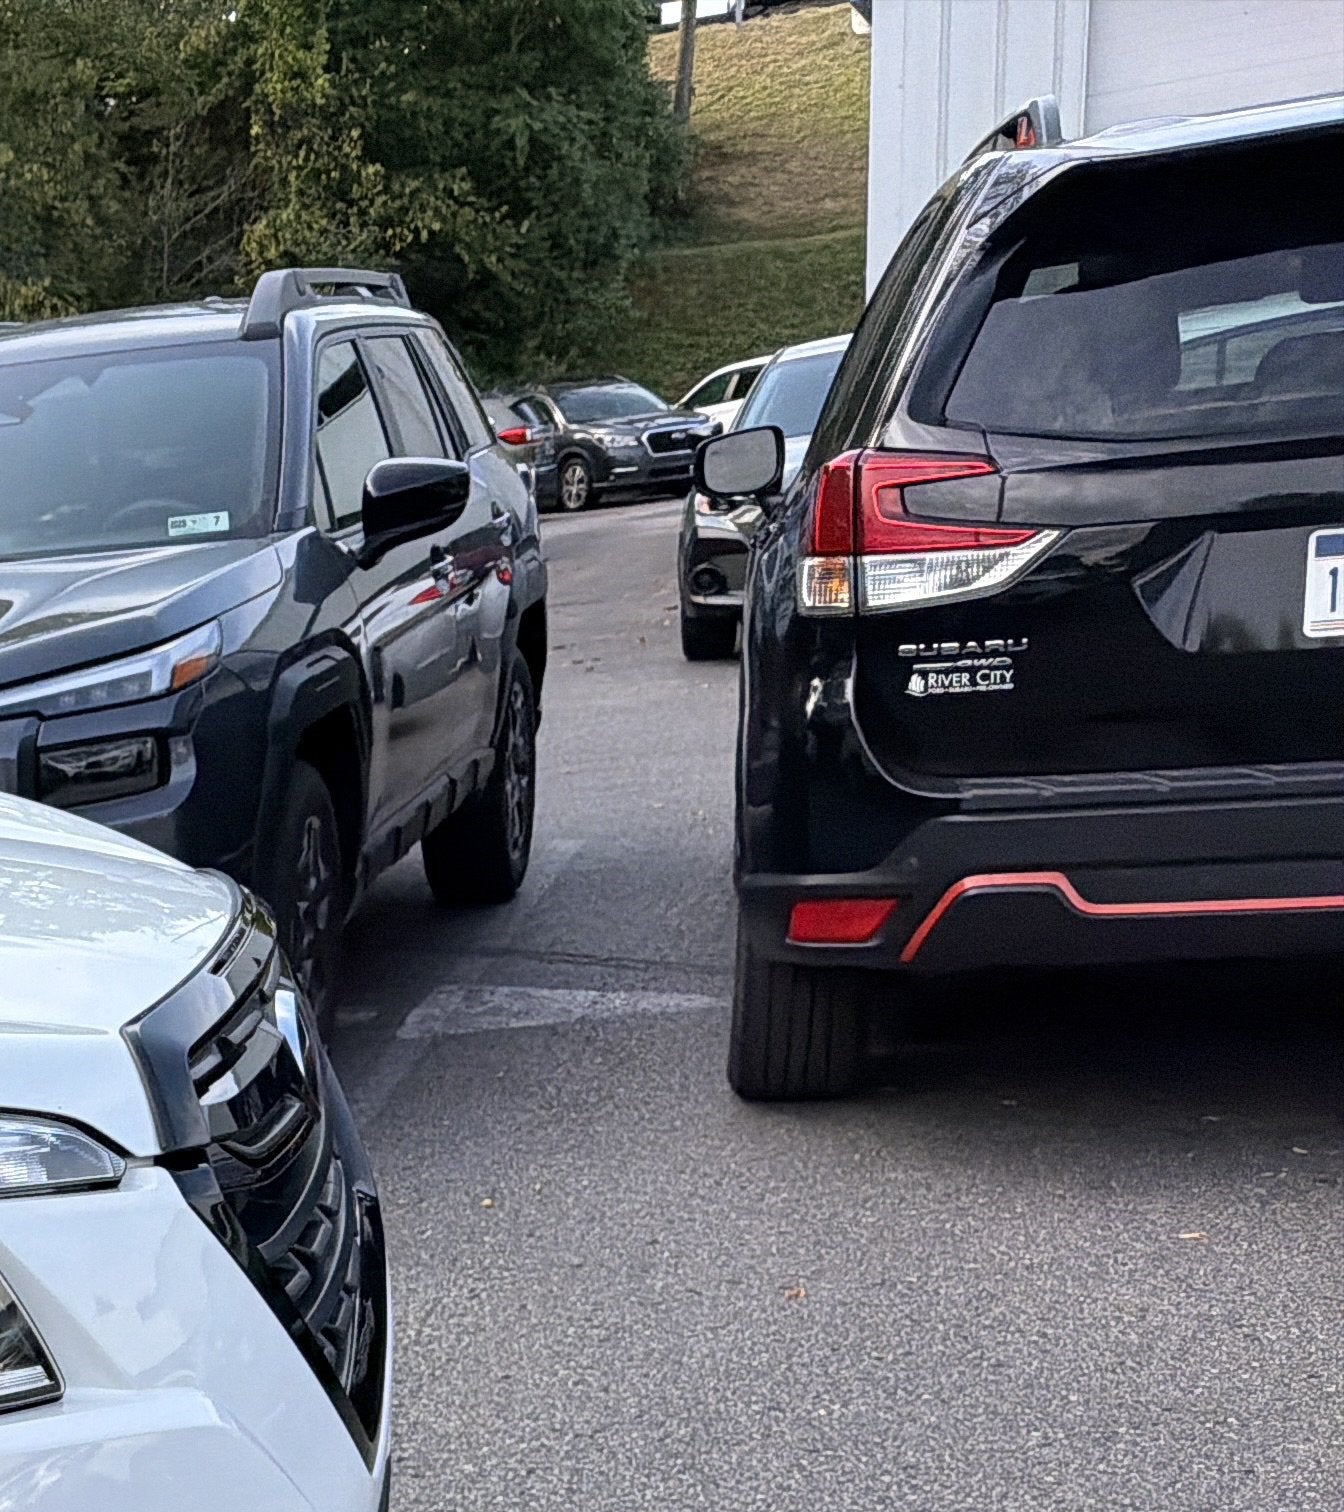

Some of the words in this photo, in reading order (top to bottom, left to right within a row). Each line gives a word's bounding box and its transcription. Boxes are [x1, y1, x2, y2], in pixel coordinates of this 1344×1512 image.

[898, 638, 1028, 656] SUBARU
[928, 672, 970, 688] RIVER
[976, 669, 1014, 685] CITY
